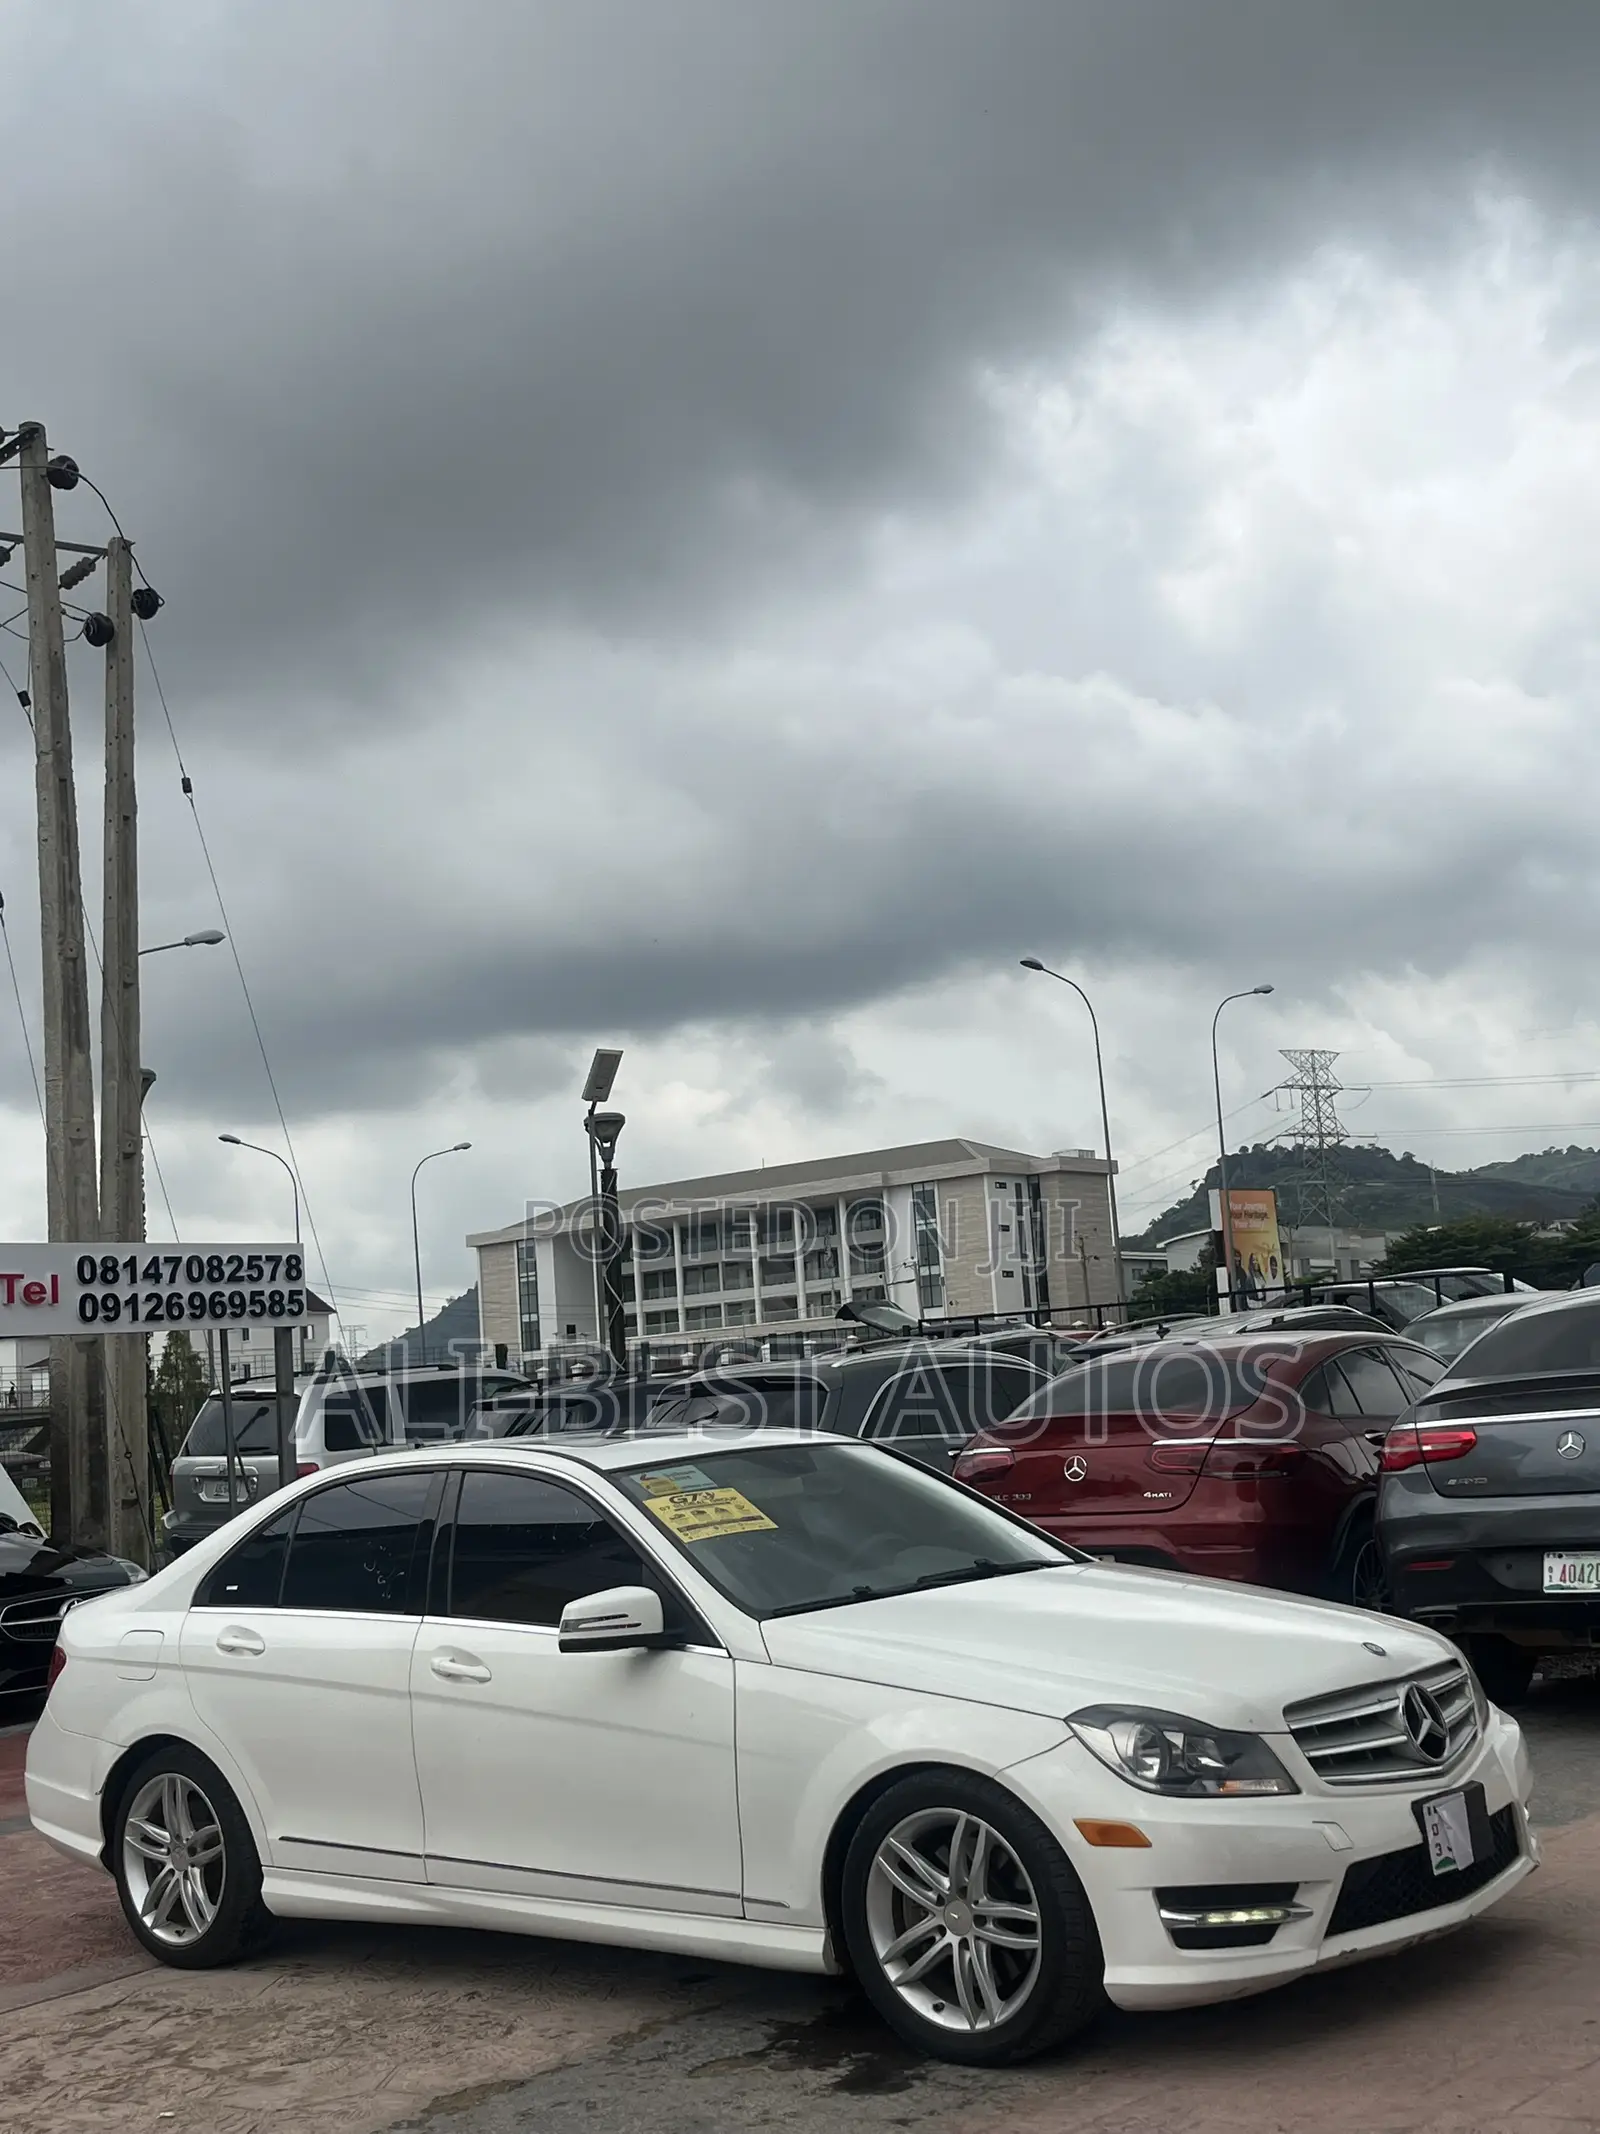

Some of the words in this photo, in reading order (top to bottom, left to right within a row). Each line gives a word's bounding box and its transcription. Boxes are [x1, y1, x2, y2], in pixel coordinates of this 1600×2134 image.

[76, 1254, 302, 1285] 08147082578
[0, 1273, 59, 1305] Tel
[78, 1289, 304, 1323] 09126969585
